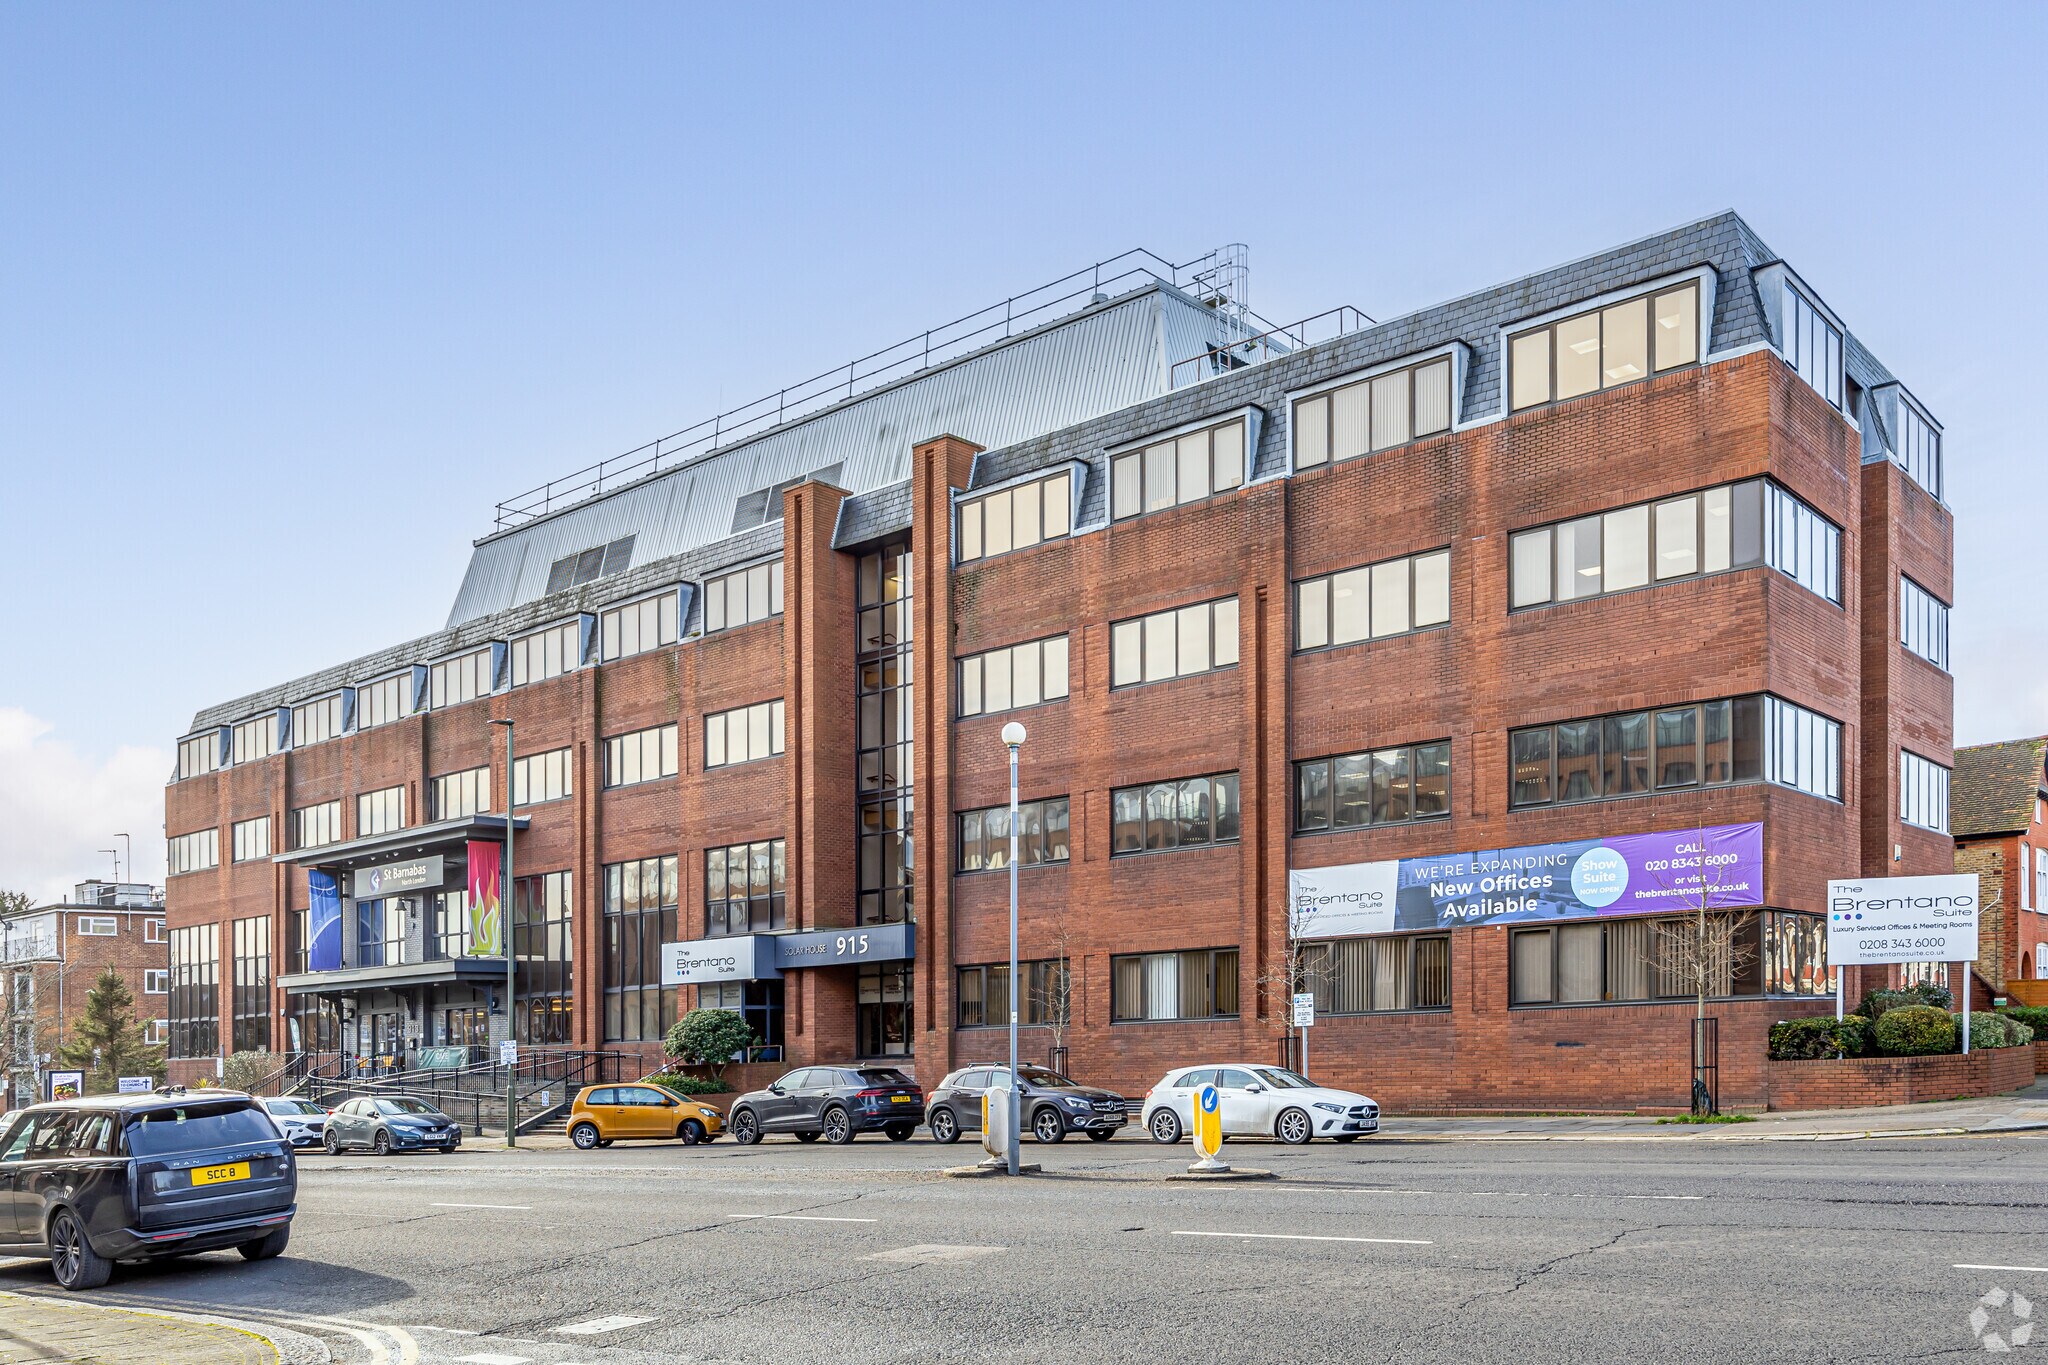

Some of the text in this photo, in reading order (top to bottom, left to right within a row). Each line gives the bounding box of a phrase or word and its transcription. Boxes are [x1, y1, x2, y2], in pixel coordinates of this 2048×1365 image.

[1675, 843, 1706, 854] CALL
[1415, 853, 1567, 879] WE'RE EXPANDING
[1582, 860, 1617, 871] Show
[1645, 853, 1738, 871] 020 8343 6000
[383, 864, 426, 880] St Barnabas
[1583, 872, 1616, 883] Suite
[1687, 874, 1707, 884] vist
[1430, 873, 1553, 898] New Offices
[1580, 886, 1620, 895] NOW OPEN
[1299, 891, 1384, 906] Brentano
[1833, 896, 1973, 911] Brentano
[1443, 895, 1538, 918] Available
[1933, 908, 1972, 917] Suite
[1919, 922, 1947, 930] Meeting
[784, 934, 869, 956] SOLAR HOUSE 915
[1859, 937, 1946, 950] 0208 343 6000
[1859, 949, 1945, 958] thebrentanosuite.co.uk
[676, 957, 735, 969] Brentano
[207, 1168, 236, 1180] SCC 8
